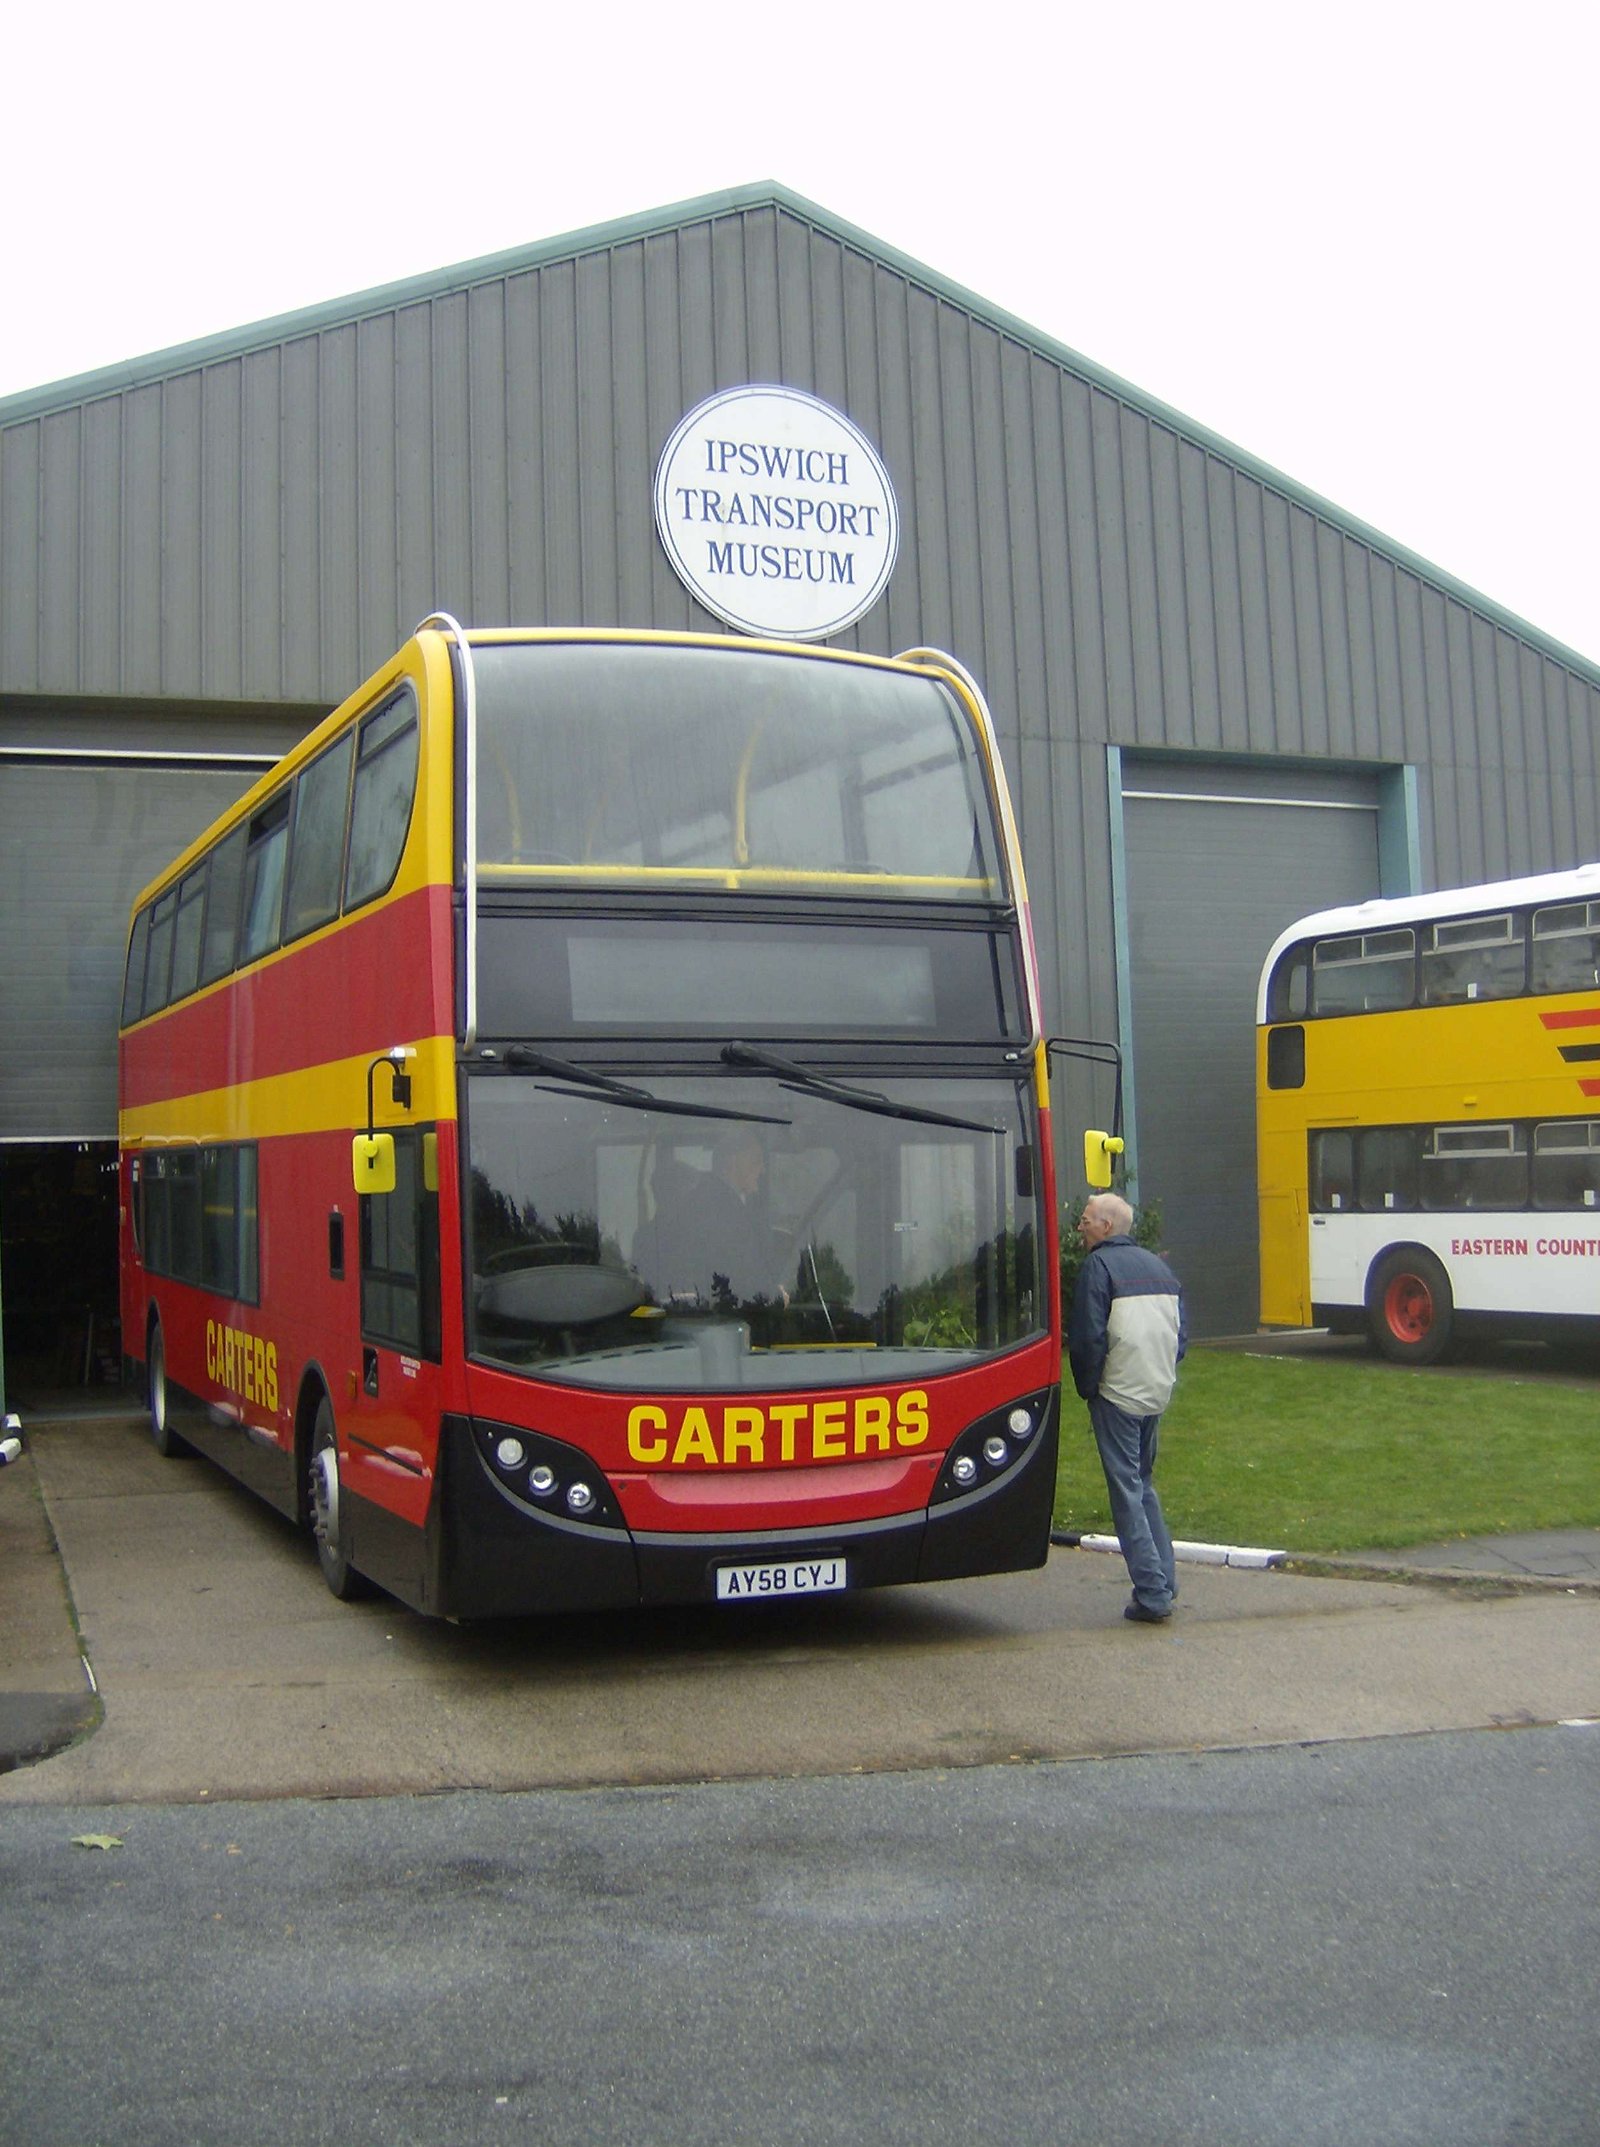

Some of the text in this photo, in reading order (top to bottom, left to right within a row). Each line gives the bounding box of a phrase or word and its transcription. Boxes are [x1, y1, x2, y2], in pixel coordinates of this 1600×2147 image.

[705, 439, 849, 485] IPSWICH
[675, 487, 880, 537] TRANSPORT
[706, 540, 856, 585] MUSEUM
[1451, 1239, 1528, 1255] EASTERN
[207, 1319, 278, 1413] CARTERS
[627, 1390, 929, 1464] CARTERS
[728, 1563, 837, 1594] AY58 CYJ
